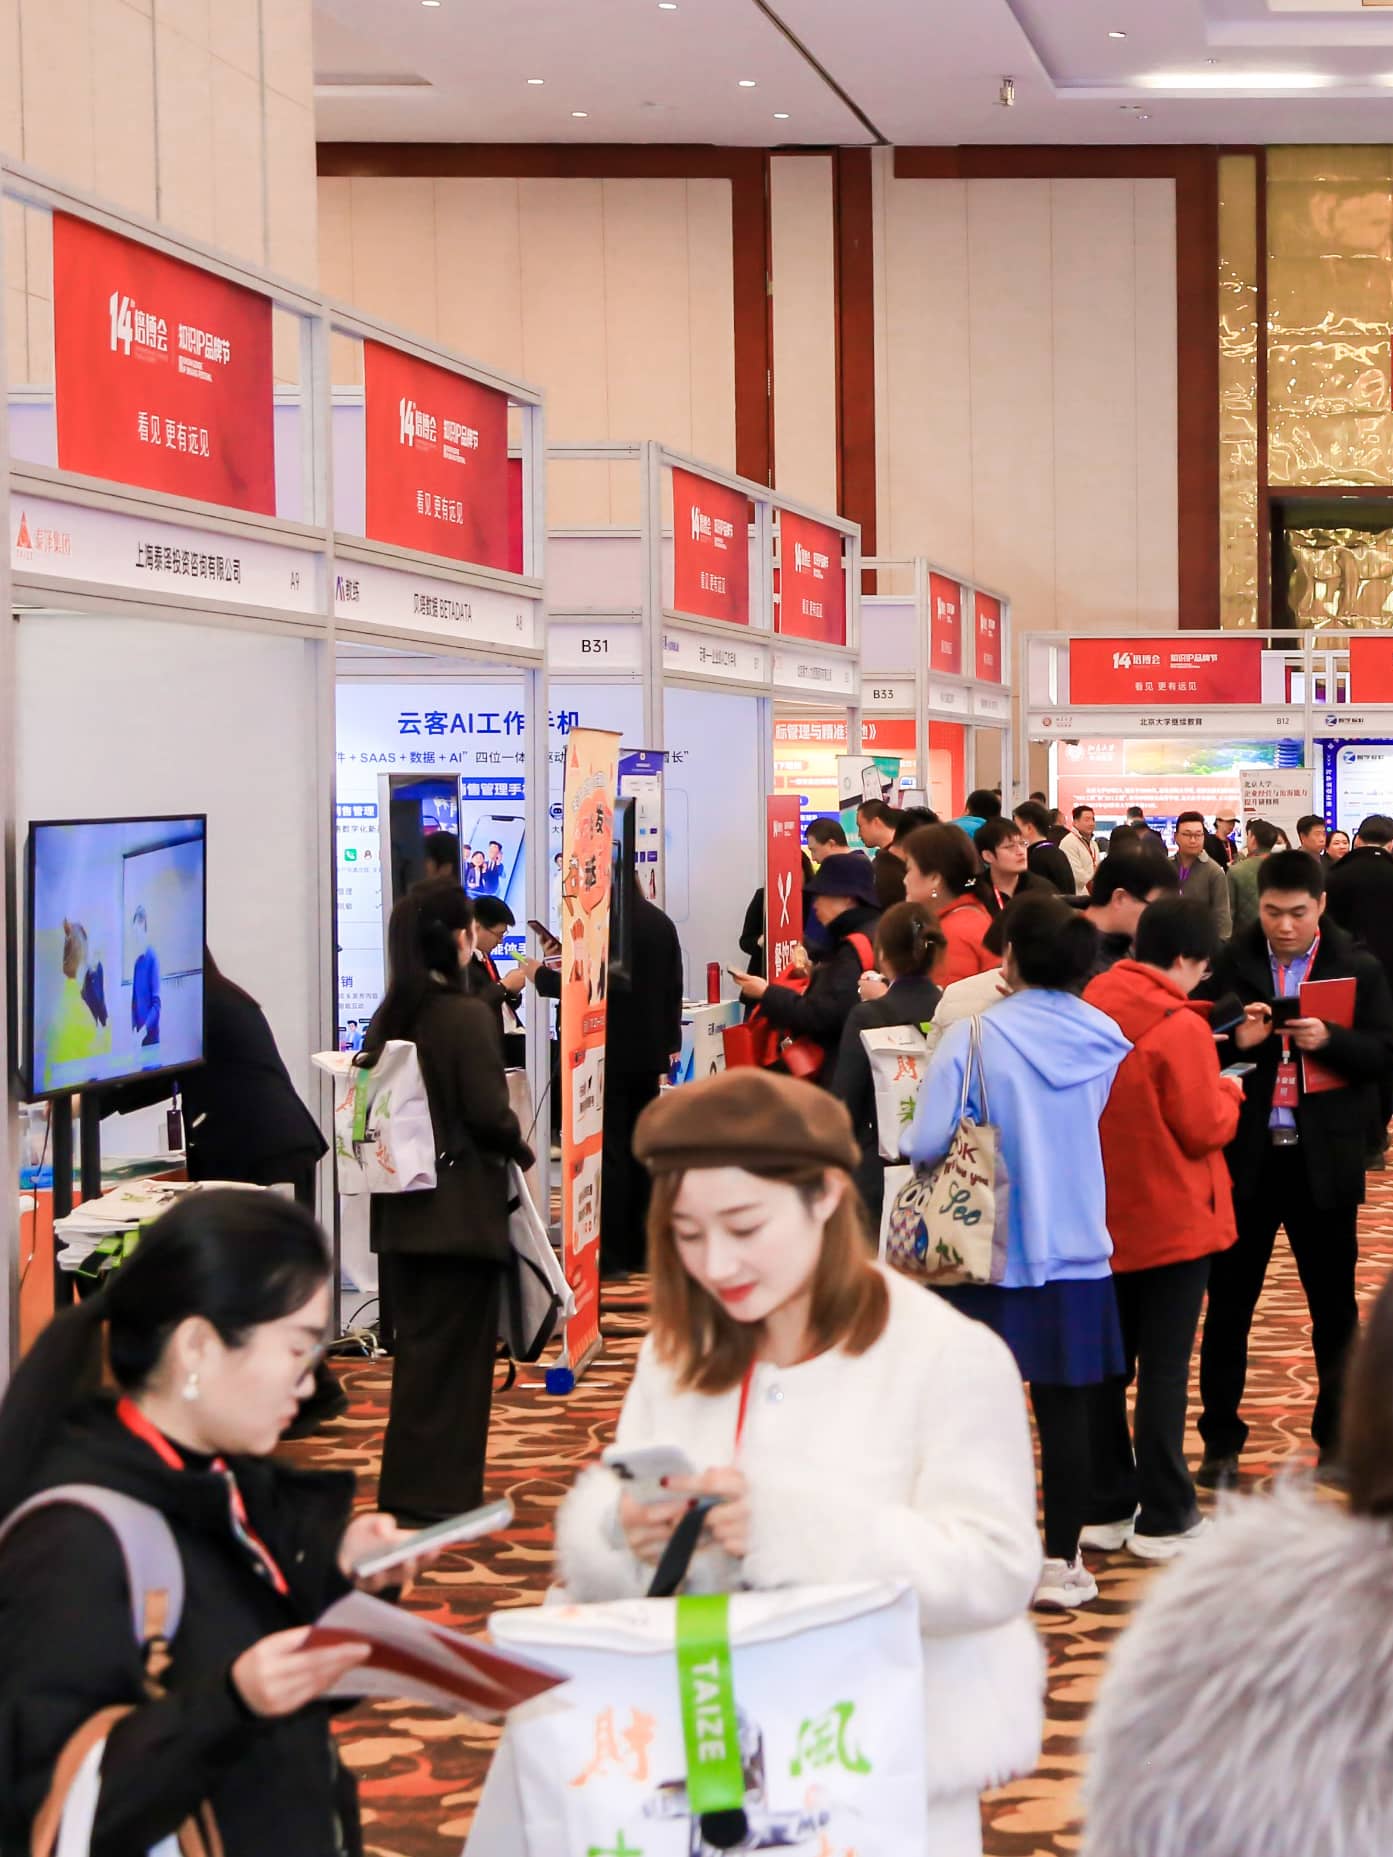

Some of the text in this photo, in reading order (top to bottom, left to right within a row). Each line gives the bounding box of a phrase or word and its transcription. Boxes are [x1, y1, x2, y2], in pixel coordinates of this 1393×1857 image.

[137, 411, 210, 457] 看见 更有远见
[135, 540, 241, 584] 上海泰泽投资咨询有限公司
[581, 640, 609, 653] B31
[873, 690, 894, 699] B33
[1276, 717, 1290, 725] B12
[360, 752, 396, 763] SAAS
[410, 751, 436, 764] 数据
[690, 1656, 728, 1762] TAIZE
